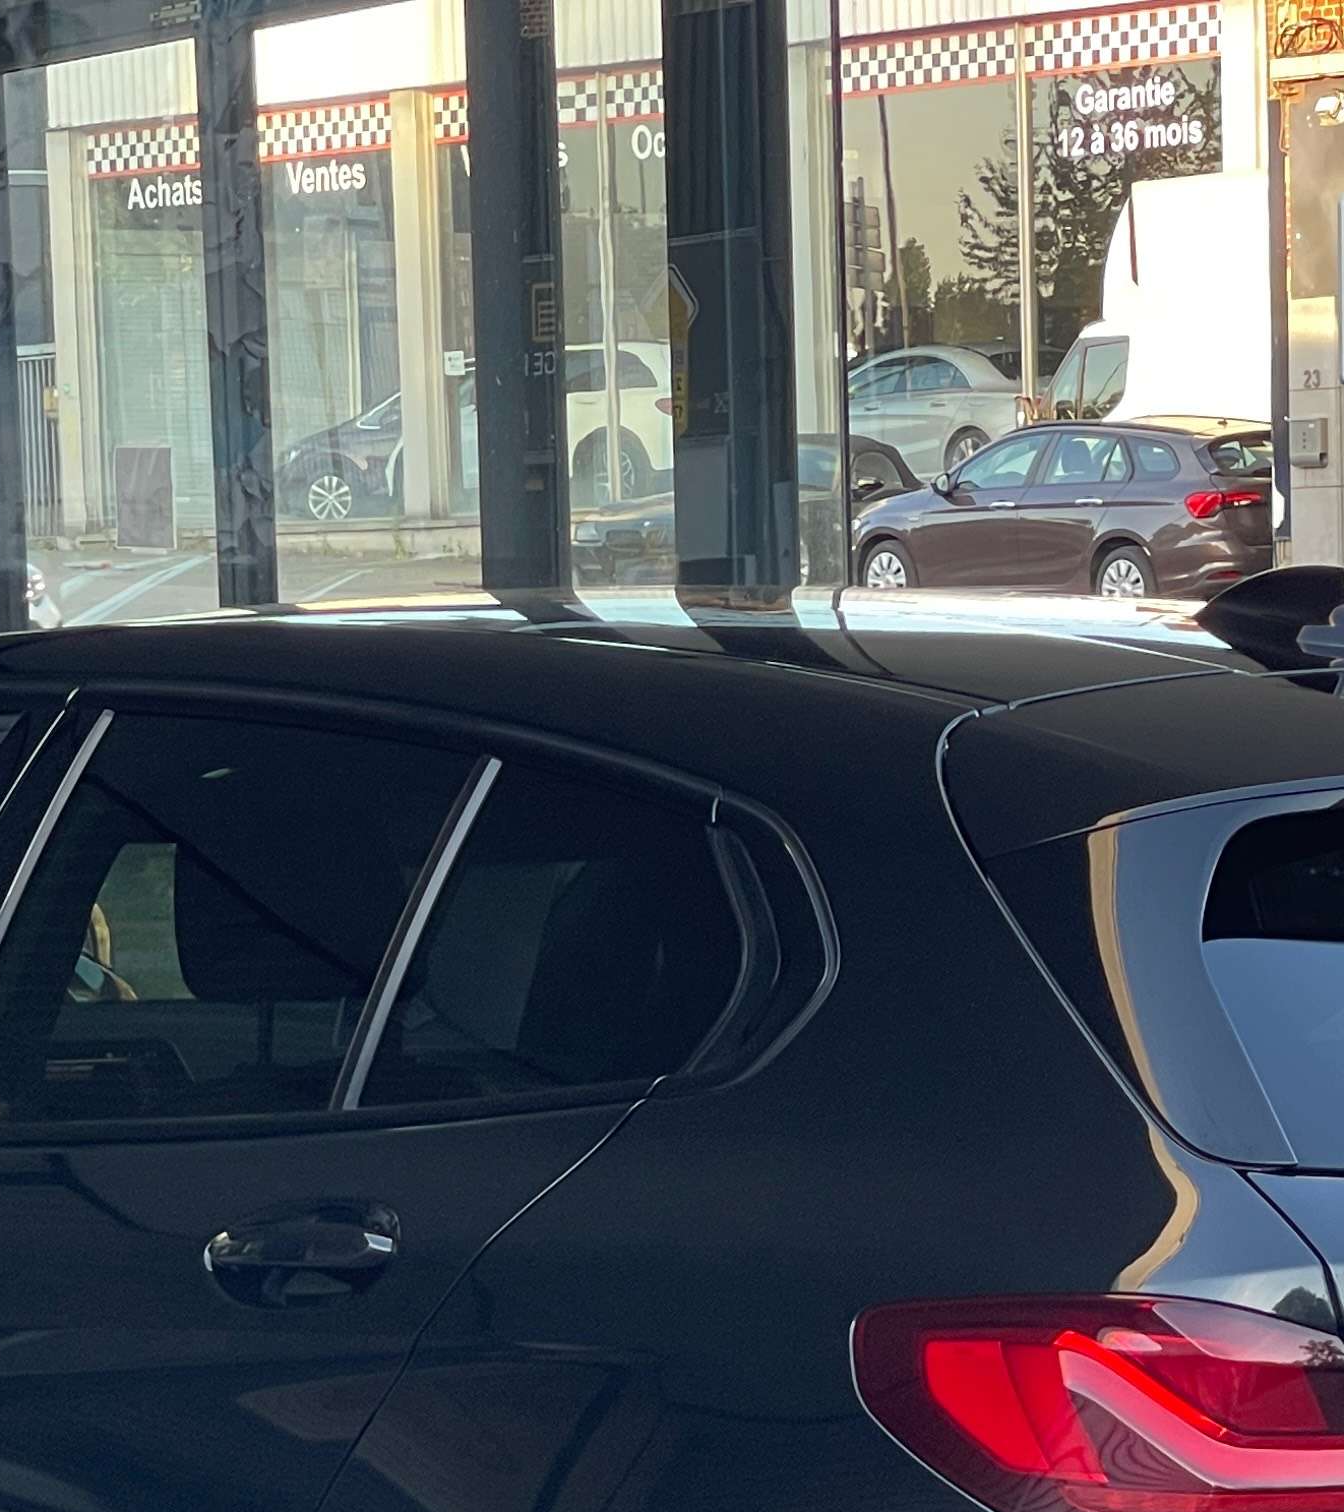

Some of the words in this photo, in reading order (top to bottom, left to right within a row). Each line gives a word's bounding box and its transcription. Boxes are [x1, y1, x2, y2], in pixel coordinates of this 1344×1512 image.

[1075, 75, 1176, 115] Garantie
[1058, 126, 1085, 157] 12
[1090, 123, 1105, 155] à
[1110, 120, 1139, 152] 36
[1144, 114, 1204, 149] mois
[127, 174, 203, 210] Achats
[285, 160, 367, 194] Ventes
[1303, 369, 1322, 389] 23
